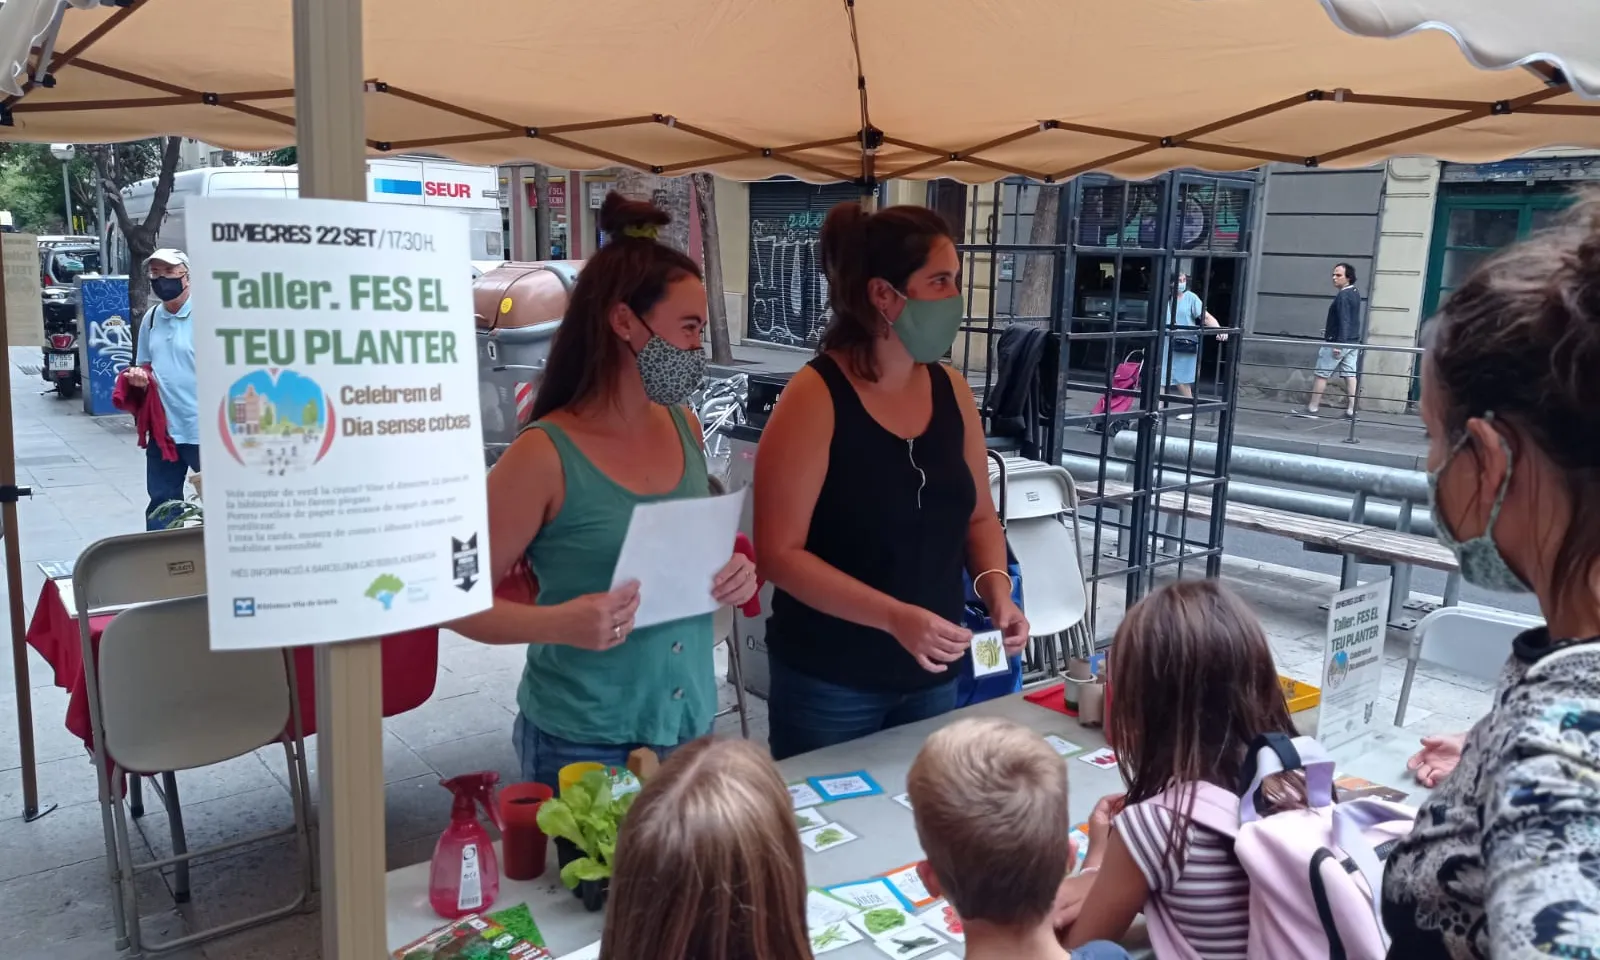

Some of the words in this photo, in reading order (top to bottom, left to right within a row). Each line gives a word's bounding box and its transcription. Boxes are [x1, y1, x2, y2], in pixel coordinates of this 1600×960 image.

[424, 181, 471, 198] SEUR
[211, 222, 312, 245] DIMECRES
[316, 226, 341, 246] 22
[212, 270, 341, 310] Taller.
[350, 274, 412, 312] FES
[419, 277, 449, 313] EL
[215, 328, 295, 366] TEU
[304, 329, 458, 366] PLANTER
[340, 385, 426, 406] Celebrem
[429, 383, 441, 402] el
[377, 416, 425, 434] sense
[429, 413, 471, 432] cotxes
[1356, 608, 1371, 626] FES
[1332, 636, 1346, 652] TEU
[1346, 625, 1379, 647] PLANTER
